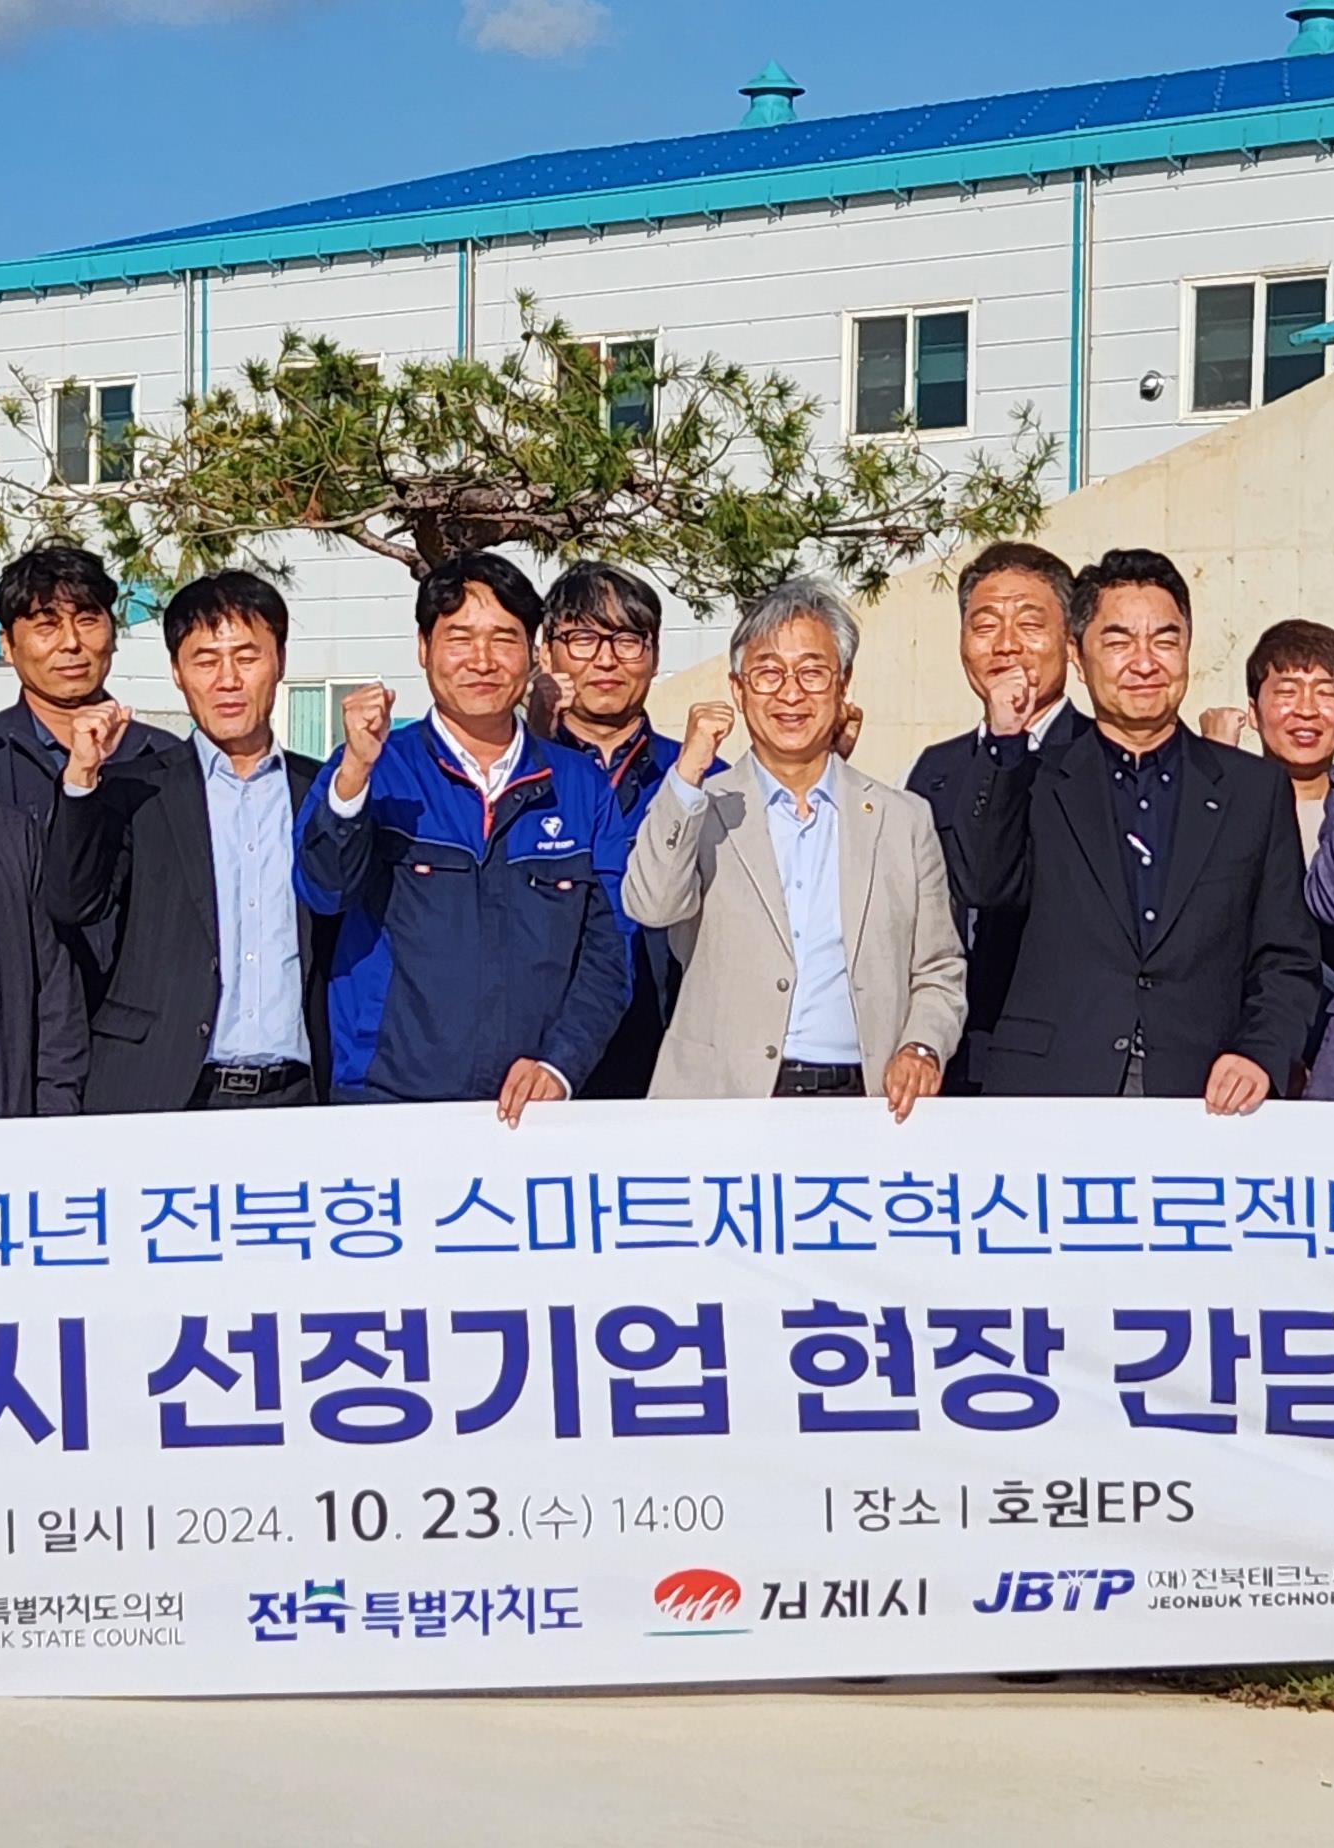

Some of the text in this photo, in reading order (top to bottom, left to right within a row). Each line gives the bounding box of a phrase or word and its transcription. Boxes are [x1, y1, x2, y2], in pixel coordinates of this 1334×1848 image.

[140, 1177, 404, 1265] 전북형
[147, 1301, 731, 1450] 선정기업
[780, 1297, 1066, 1434] 현장
[176, 1505, 294, 1545] 2024.
[314, 1488, 402, 1543] 10.
[612, 1494, 724, 1534] 14:00
[987, 1476, 1195, 1529] 호원EPS
[759, 1577, 928, 1621] 김제시
[971, 1567, 1136, 1615] JBTP
[1147, 1593, 1243, 1611] JEONBUK
[21, 1628, 86, 1649] STATE
[92, 1626, 186, 1648] COUNCIL
